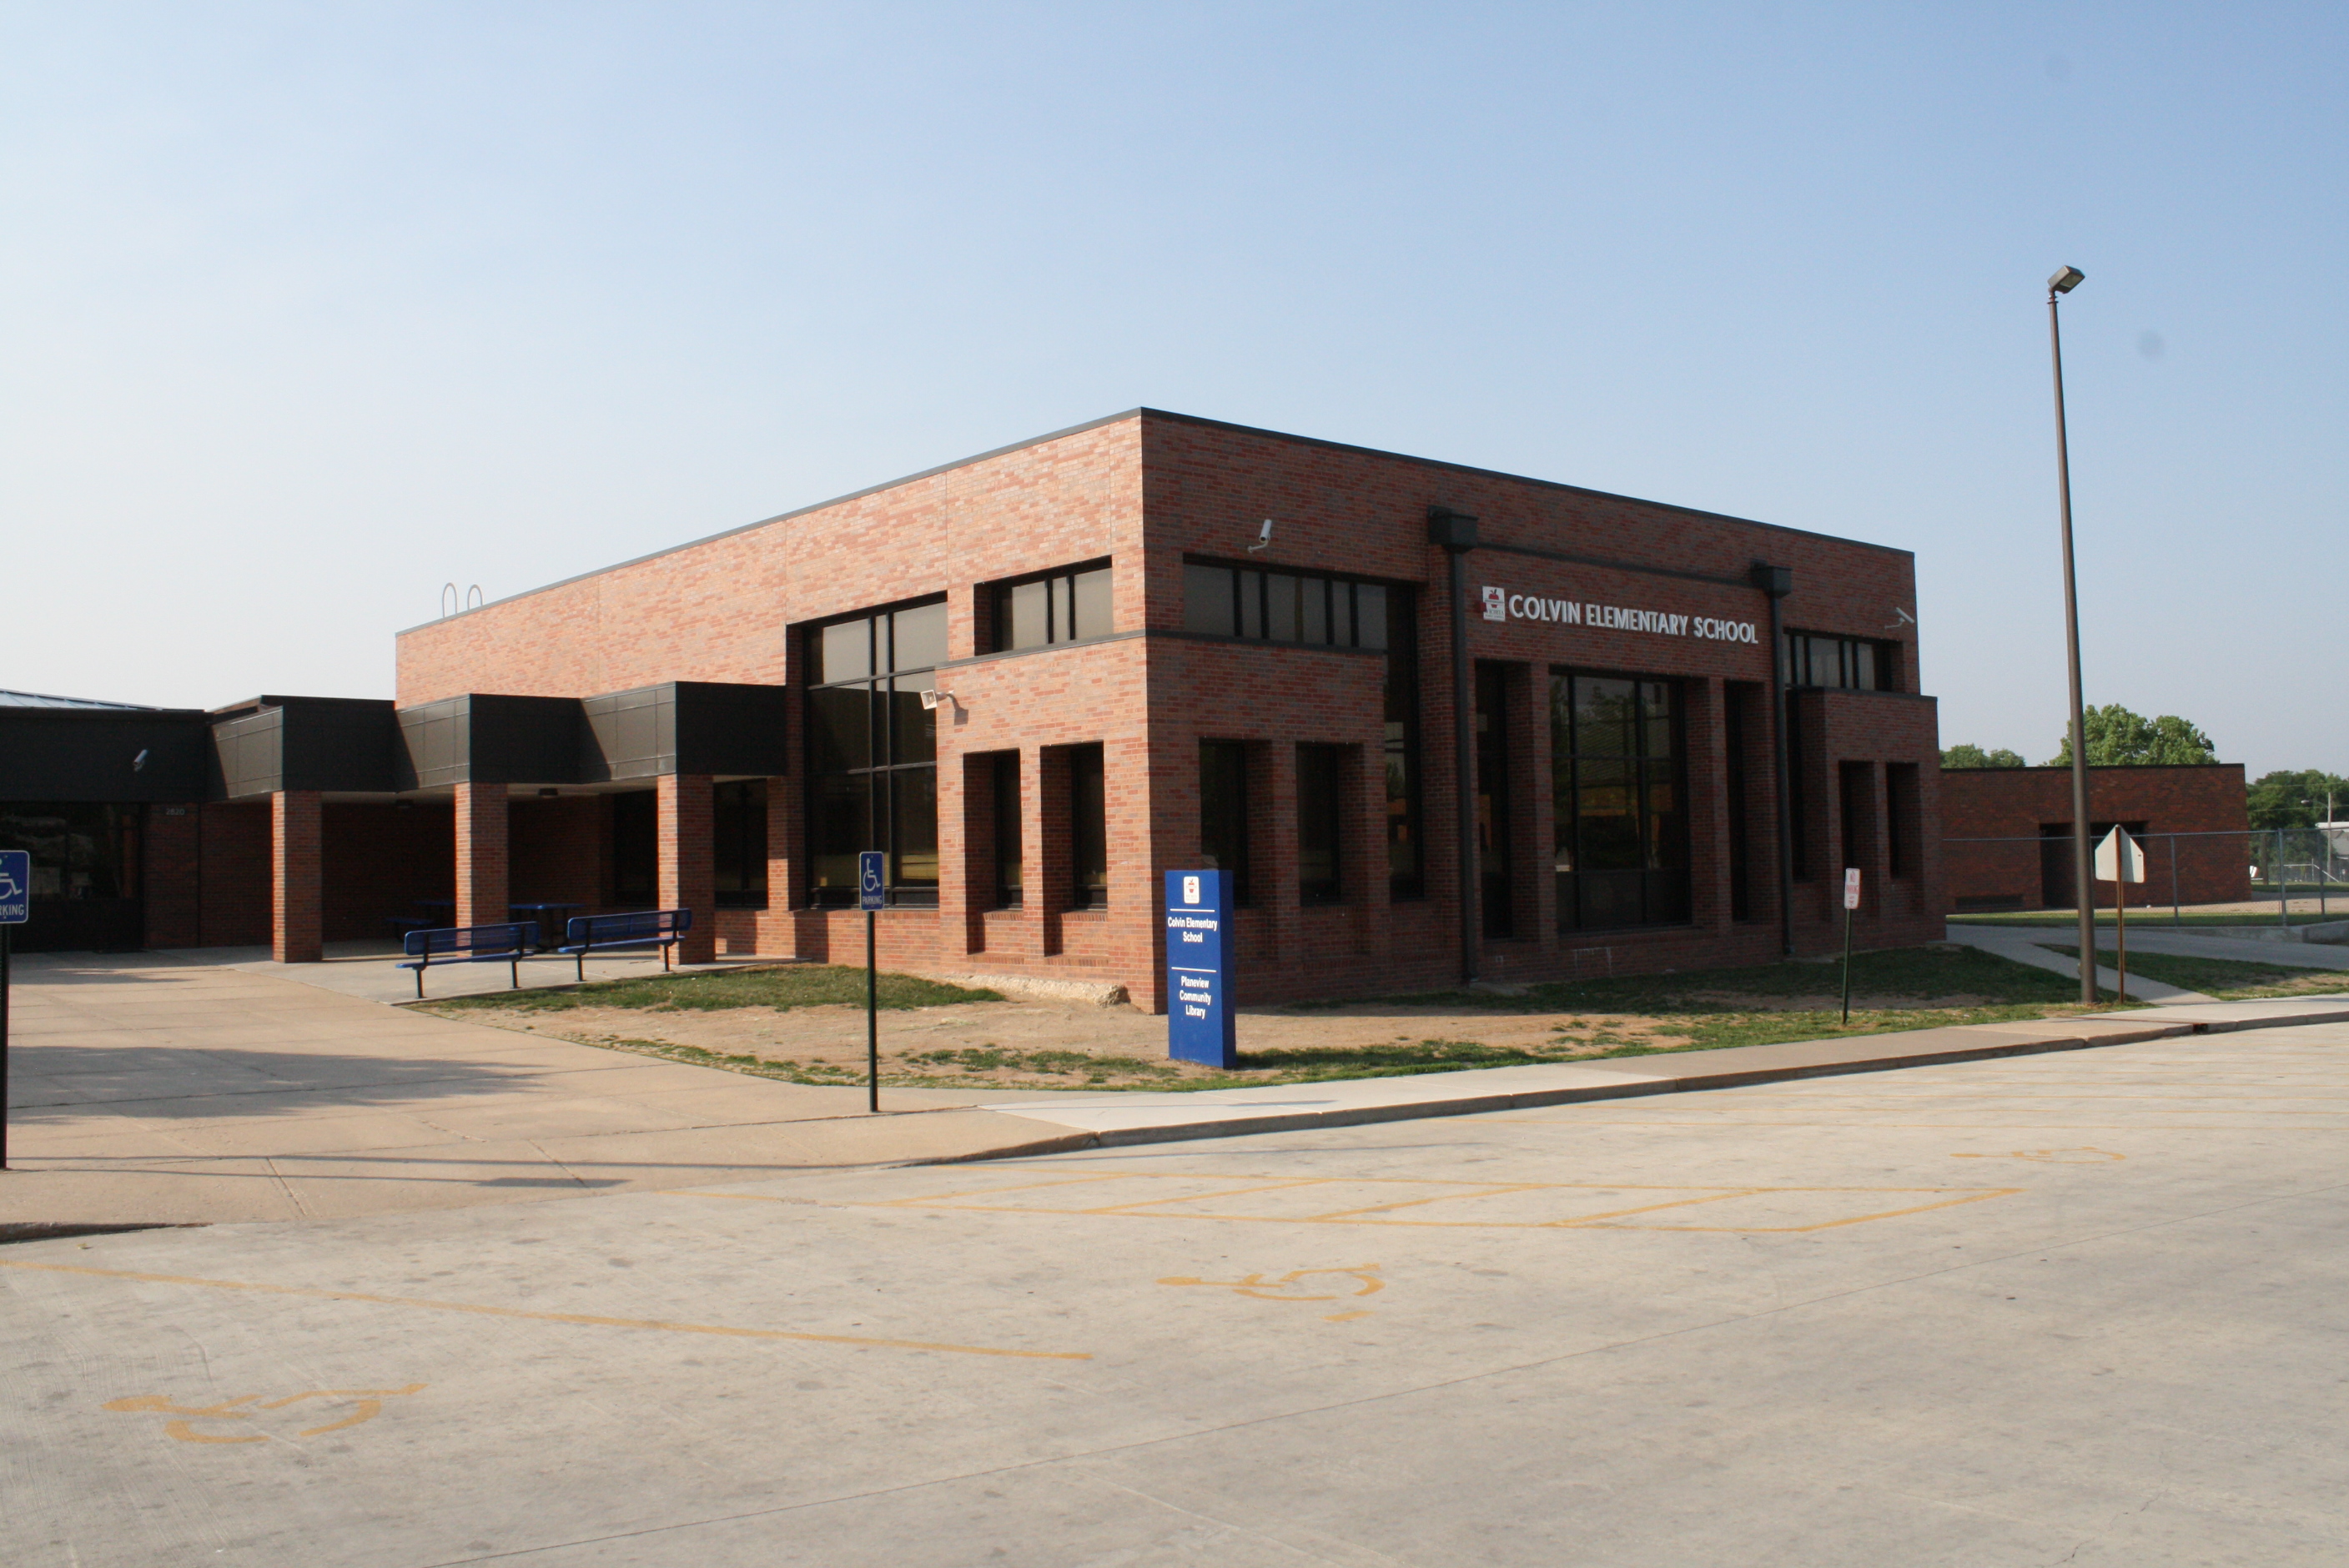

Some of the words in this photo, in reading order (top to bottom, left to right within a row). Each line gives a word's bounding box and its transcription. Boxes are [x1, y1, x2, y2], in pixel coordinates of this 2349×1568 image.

[1508, 595, 1581, 624] COLVIN
[1585, 604, 1688, 636] ELEMENTARY
[1693, 616, 1758, 644] SCHOOL
[862, 896, 883, 905] PARKING
[1168, 917, 1185, 927] Colvin
[1186, 917, 1218, 932] Elementary
[1183, 931, 1203, 942] School
[1181, 975, 1210, 988] Planeview
[1180, 990, 1211, 1005] Community
[1185, 1004, 1205, 1019] Library
